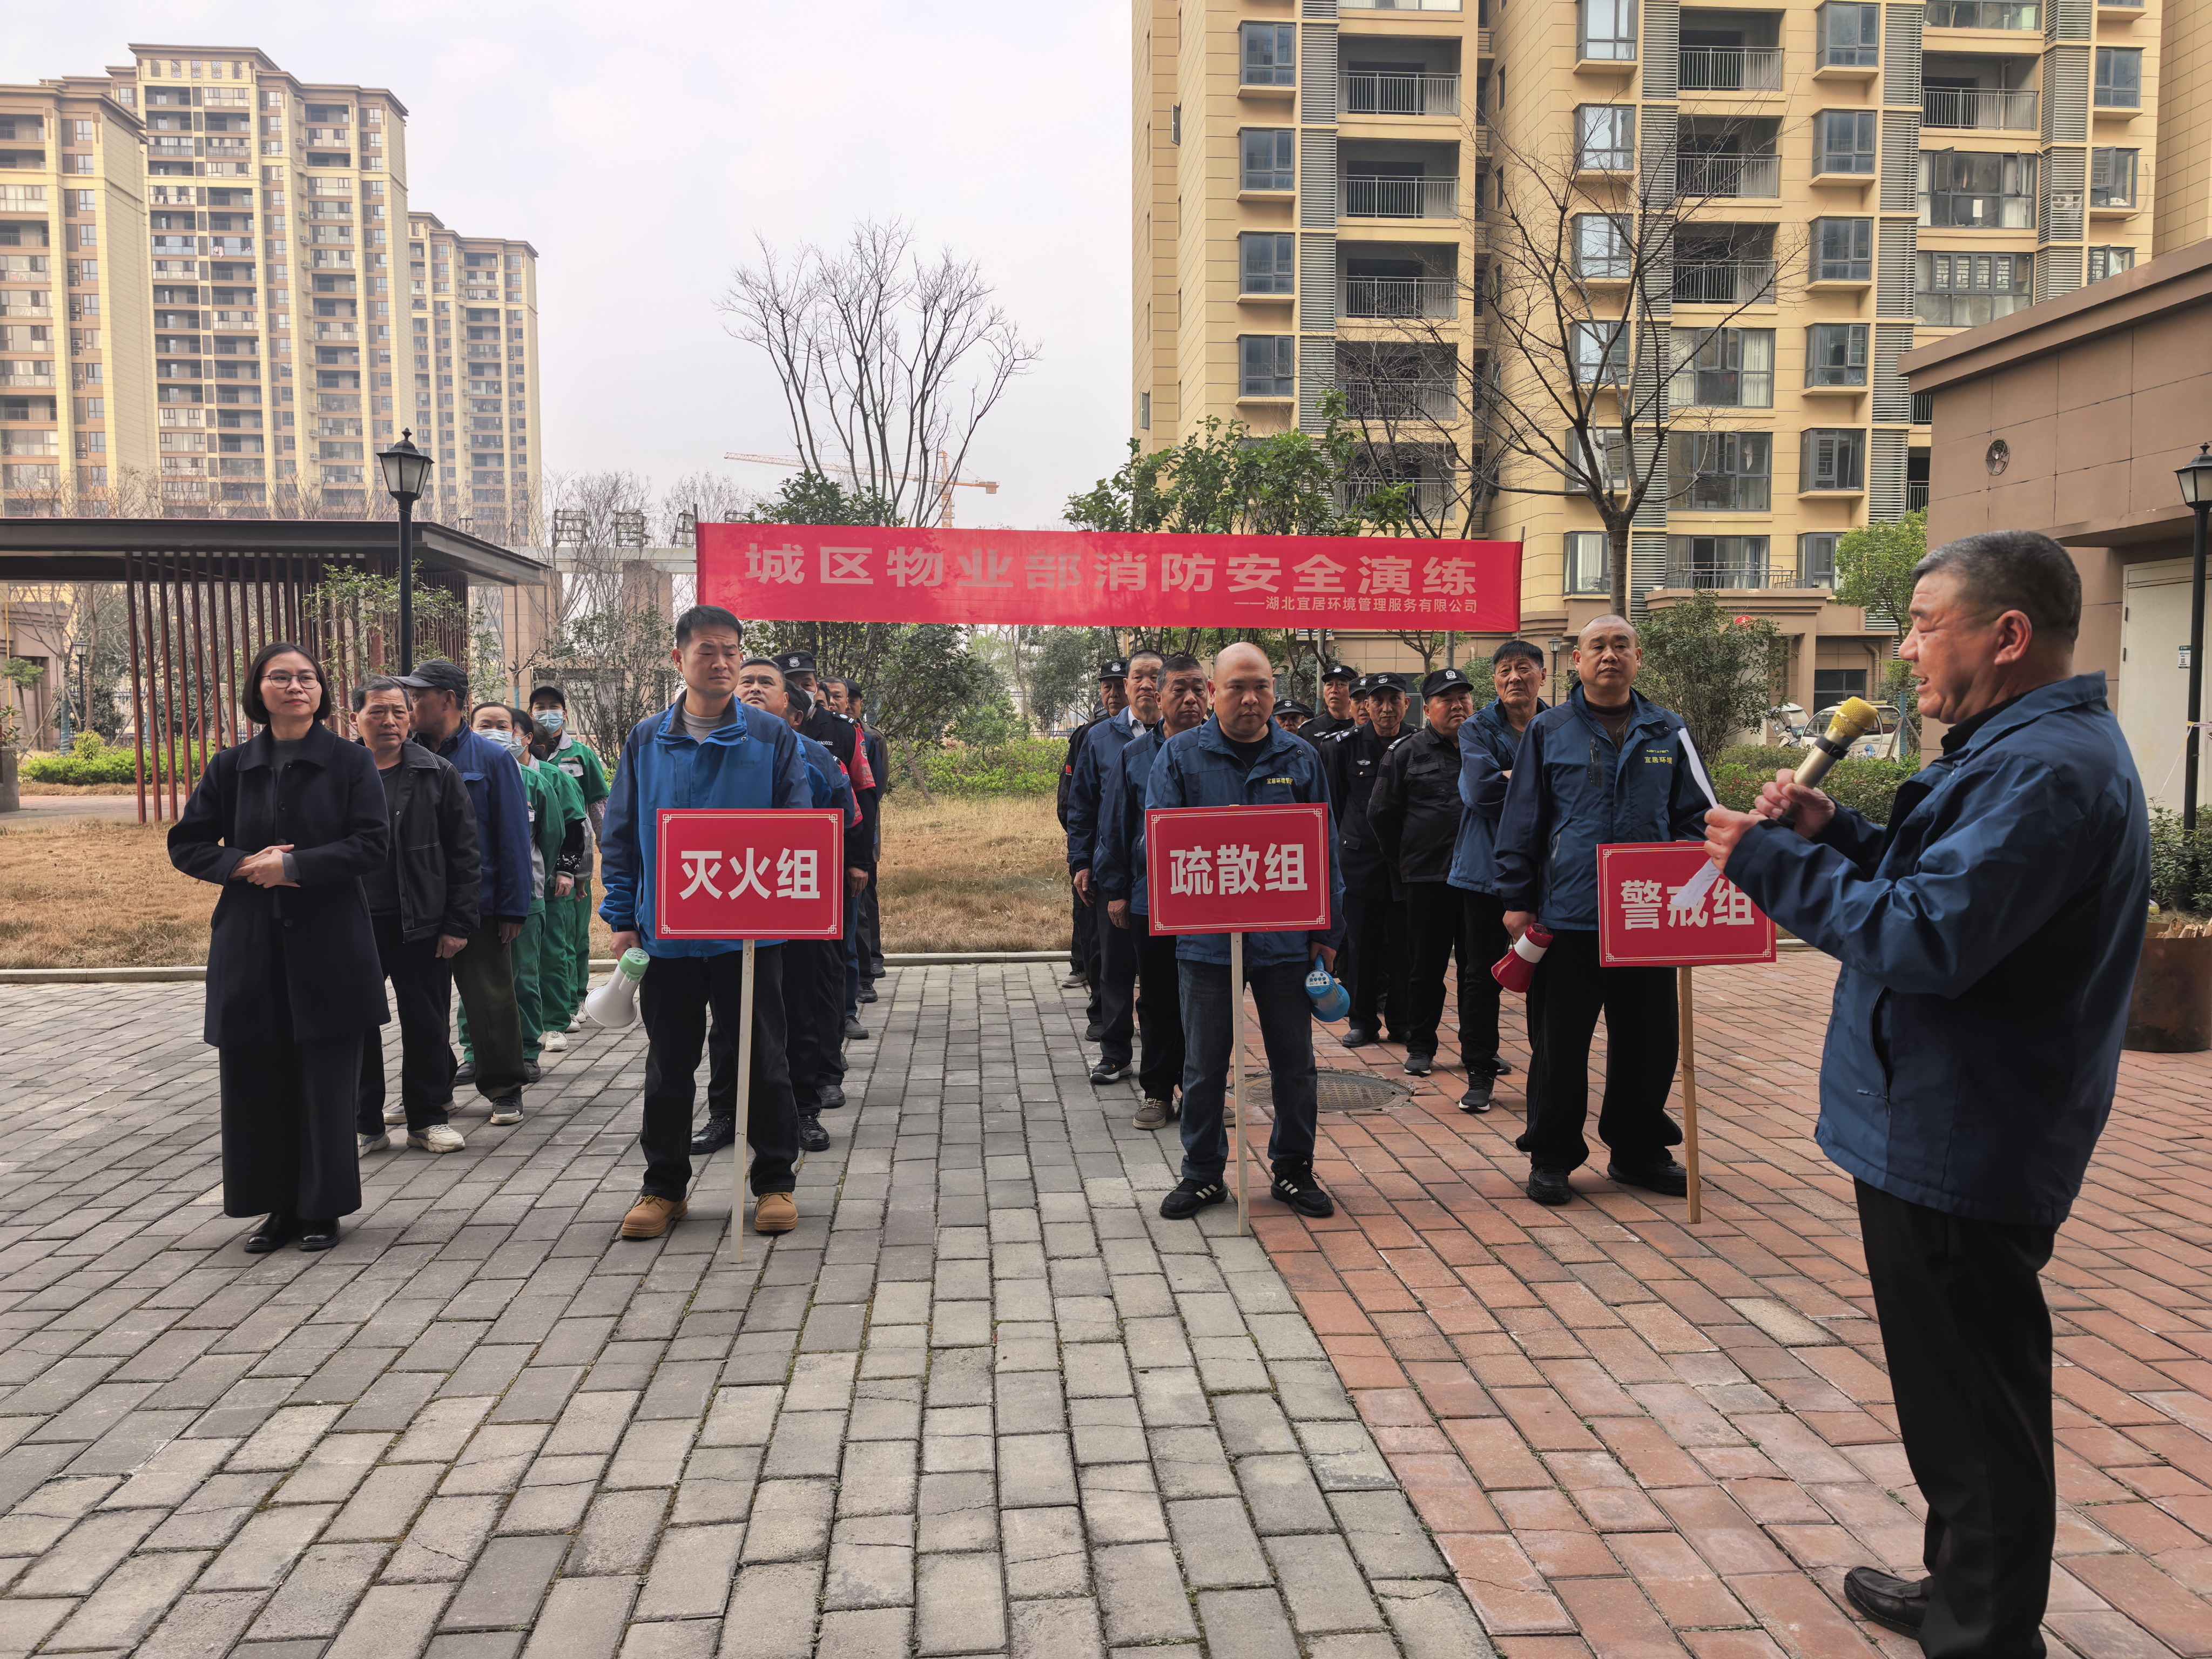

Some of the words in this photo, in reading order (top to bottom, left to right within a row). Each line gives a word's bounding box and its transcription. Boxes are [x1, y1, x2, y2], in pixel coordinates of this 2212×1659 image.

[745, 543, 1477, 595] 城区物业部消防安全演练
[679, 847, 820, 900] 灭火组
[1170, 843, 1308, 896] 疏散组
